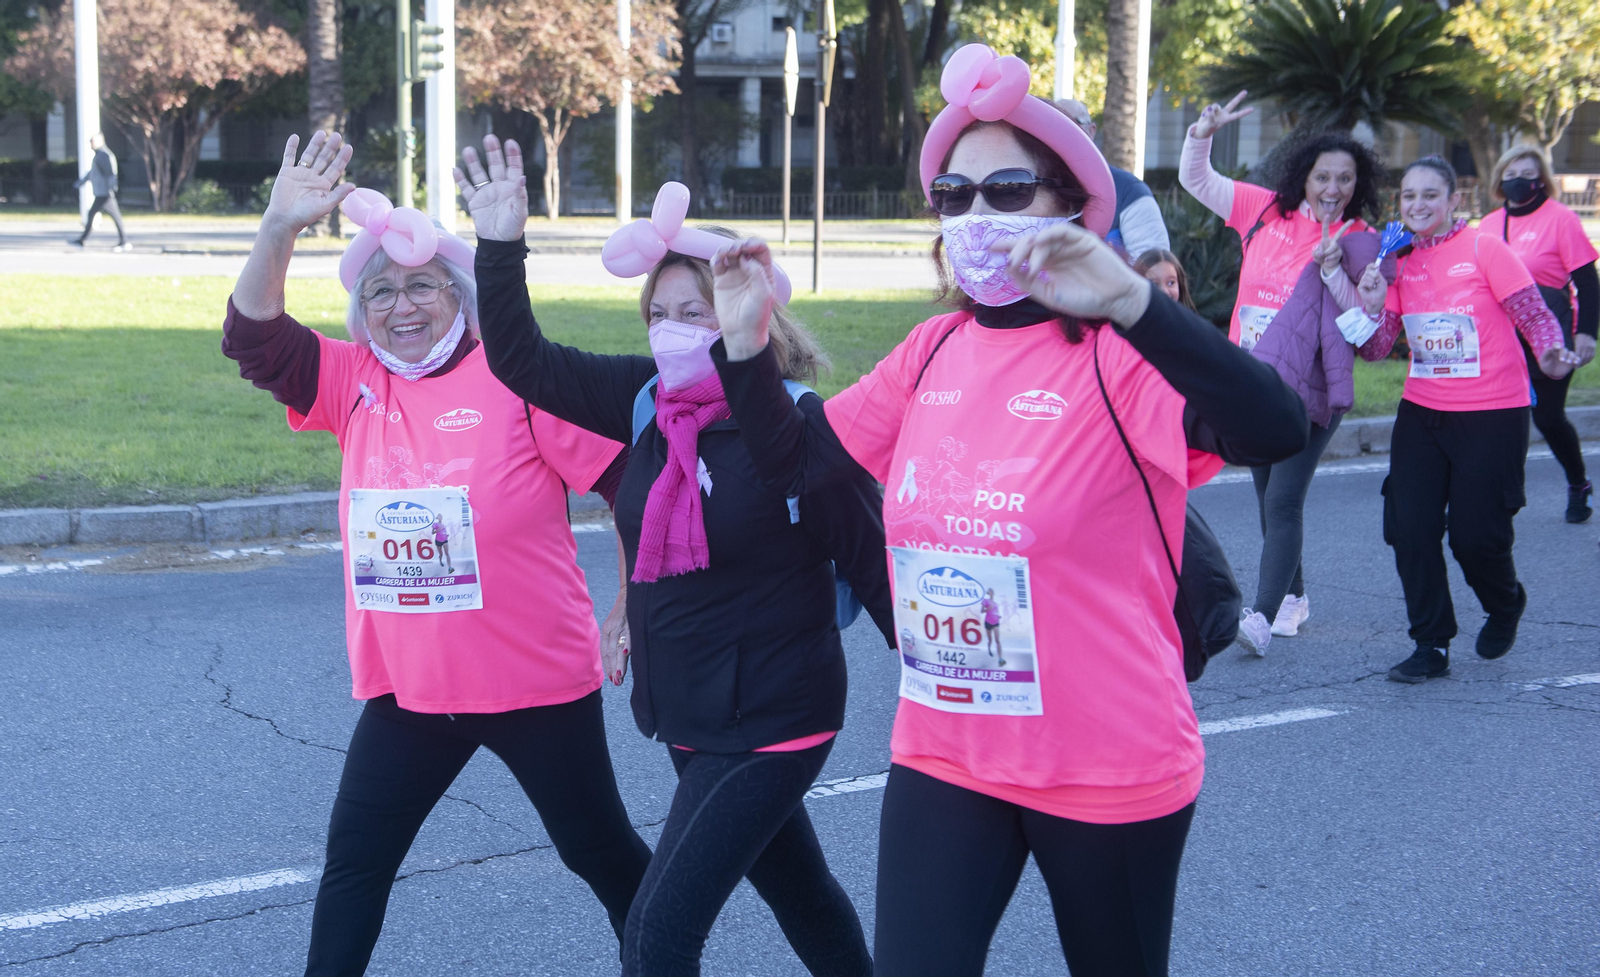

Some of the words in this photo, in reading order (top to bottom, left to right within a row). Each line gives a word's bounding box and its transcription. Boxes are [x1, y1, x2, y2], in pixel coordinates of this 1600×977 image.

[1258, 290, 1288, 305] NOSO
[1449, 304, 1474, 315] POR
[1425, 338, 1455, 351] 016
[920, 389, 962, 406] OYSHO
[1011, 398, 1063, 415] ASTURIANA
[438, 416, 479, 427] ASTURIANA
[974, 489, 1026, 513] POR
[380, 512, 431, 525] ASTURIANA
[943, 515, 1022, 542] TODAS
[383, 539, 434, 560] 016
[396, 566, 423, 577] 1439
[375, 577, 404, 587] CARRERA
[405, 578, 415, 587] DE
[416, 578, 427, 587] LA
[428, 577, 455, 586] MUJER
[922, 579, 980, 598] ASTURIANA
[360, 592, 394, 604] OYSHO
[447, 593, 473, 602] ZURICH
[924, 613, 982, 645] 016
[937, 650, 967, 666] 1442
[915, 660, 944, 676] CARRERA
[945, 668, 957, 678] DE
[958, 669, 971, 679] LA
[972, 670, 1007, 681] MUJER
[906, 676, 932, 696] OYSHO
[996, 694, 1029, 702] ZURICH
